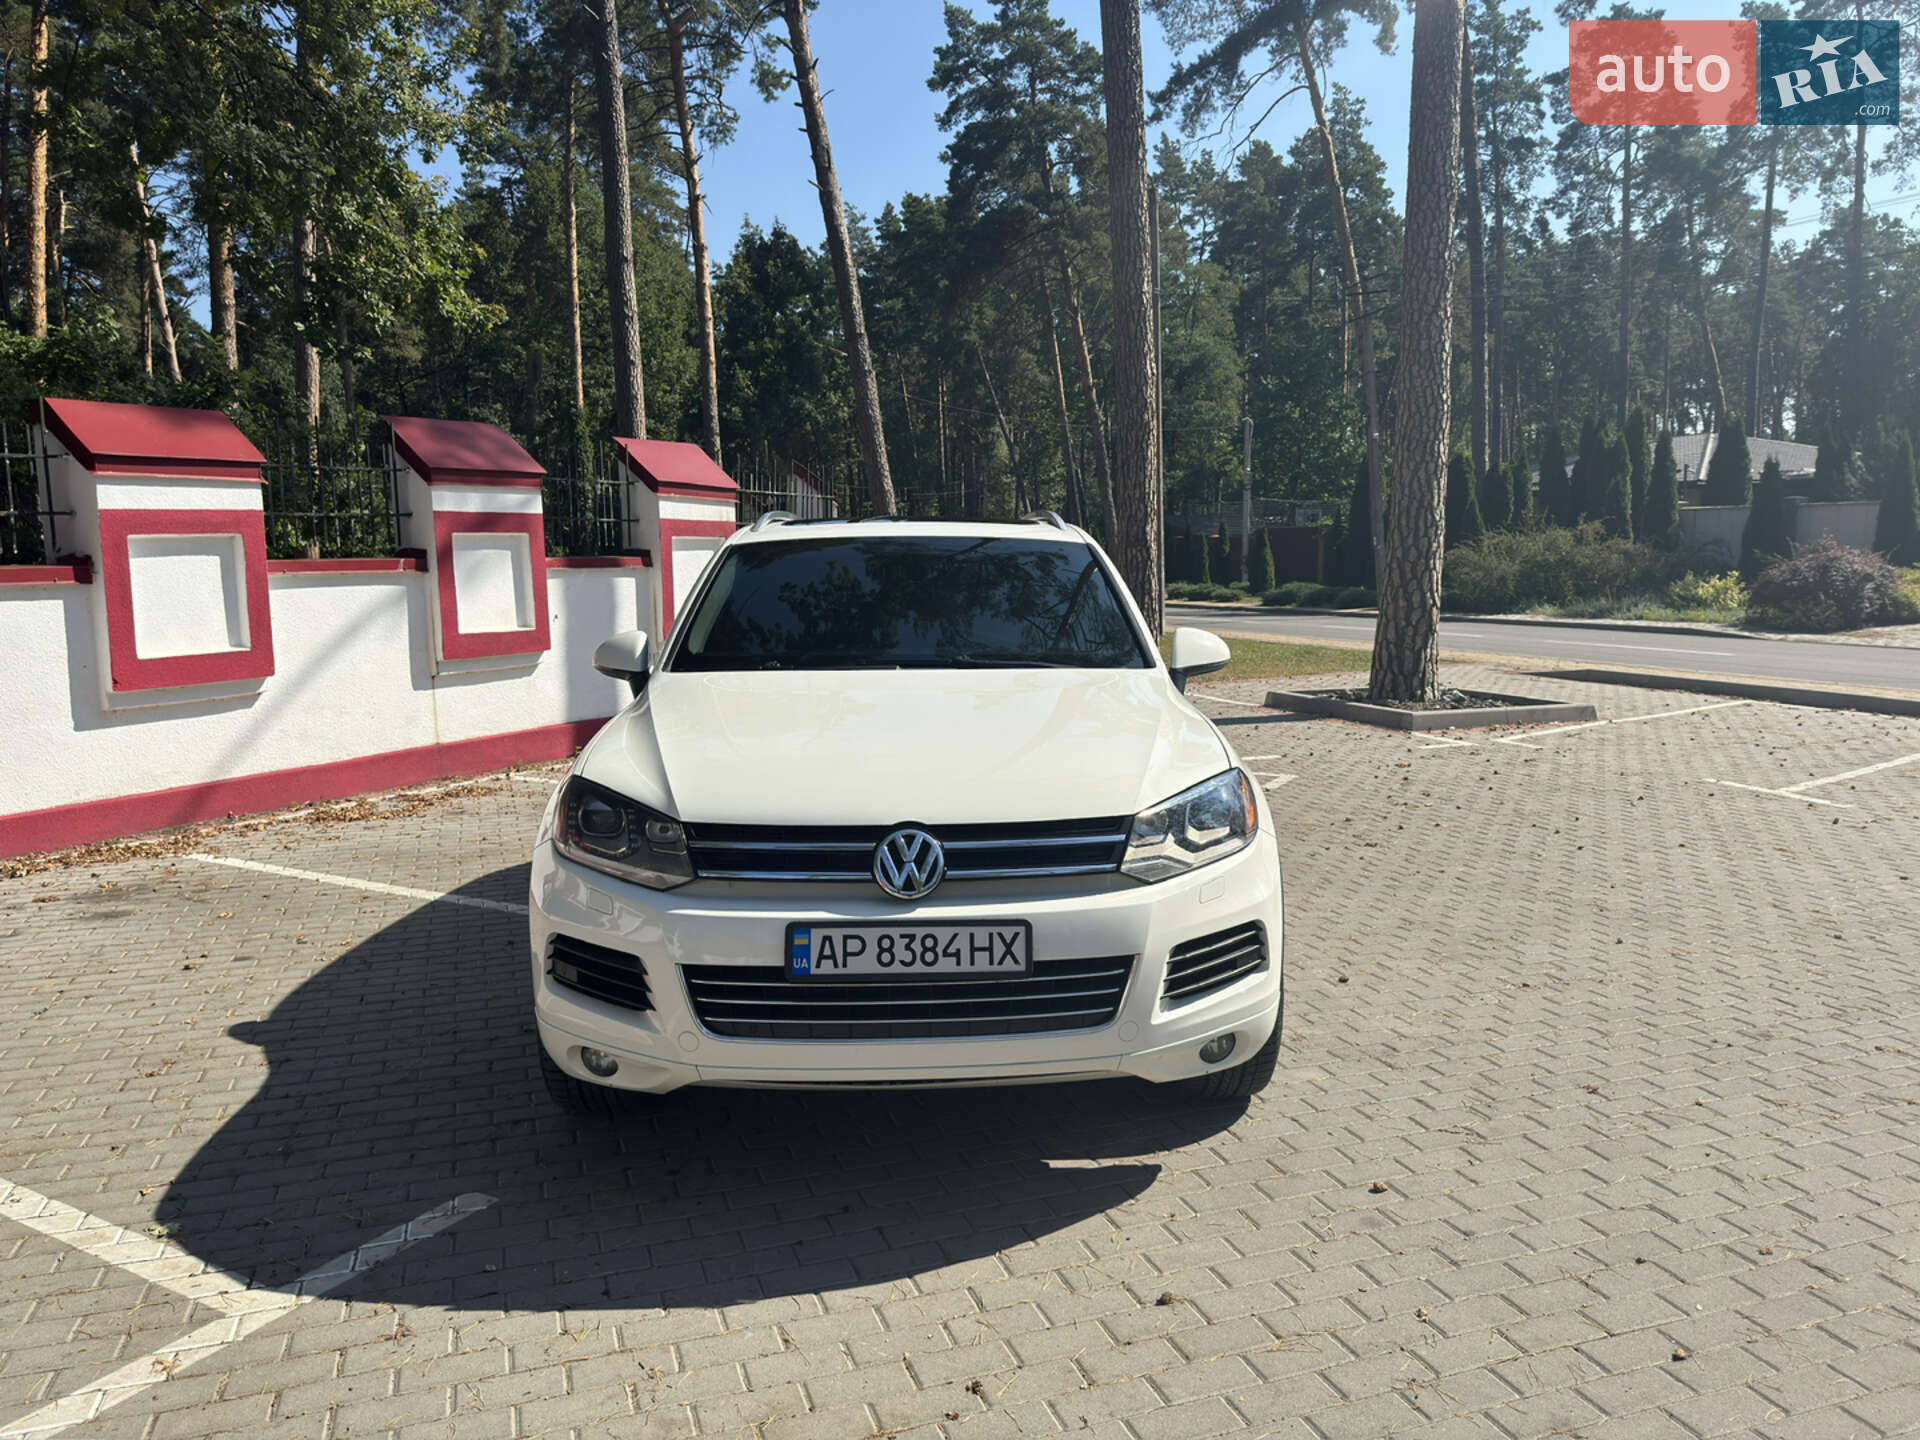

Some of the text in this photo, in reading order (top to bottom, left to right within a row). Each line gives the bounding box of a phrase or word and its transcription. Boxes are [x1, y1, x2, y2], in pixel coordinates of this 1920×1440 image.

[815, 931, 1021, 969] AP 8384 HX
[793, 958, 808, 969] UA
